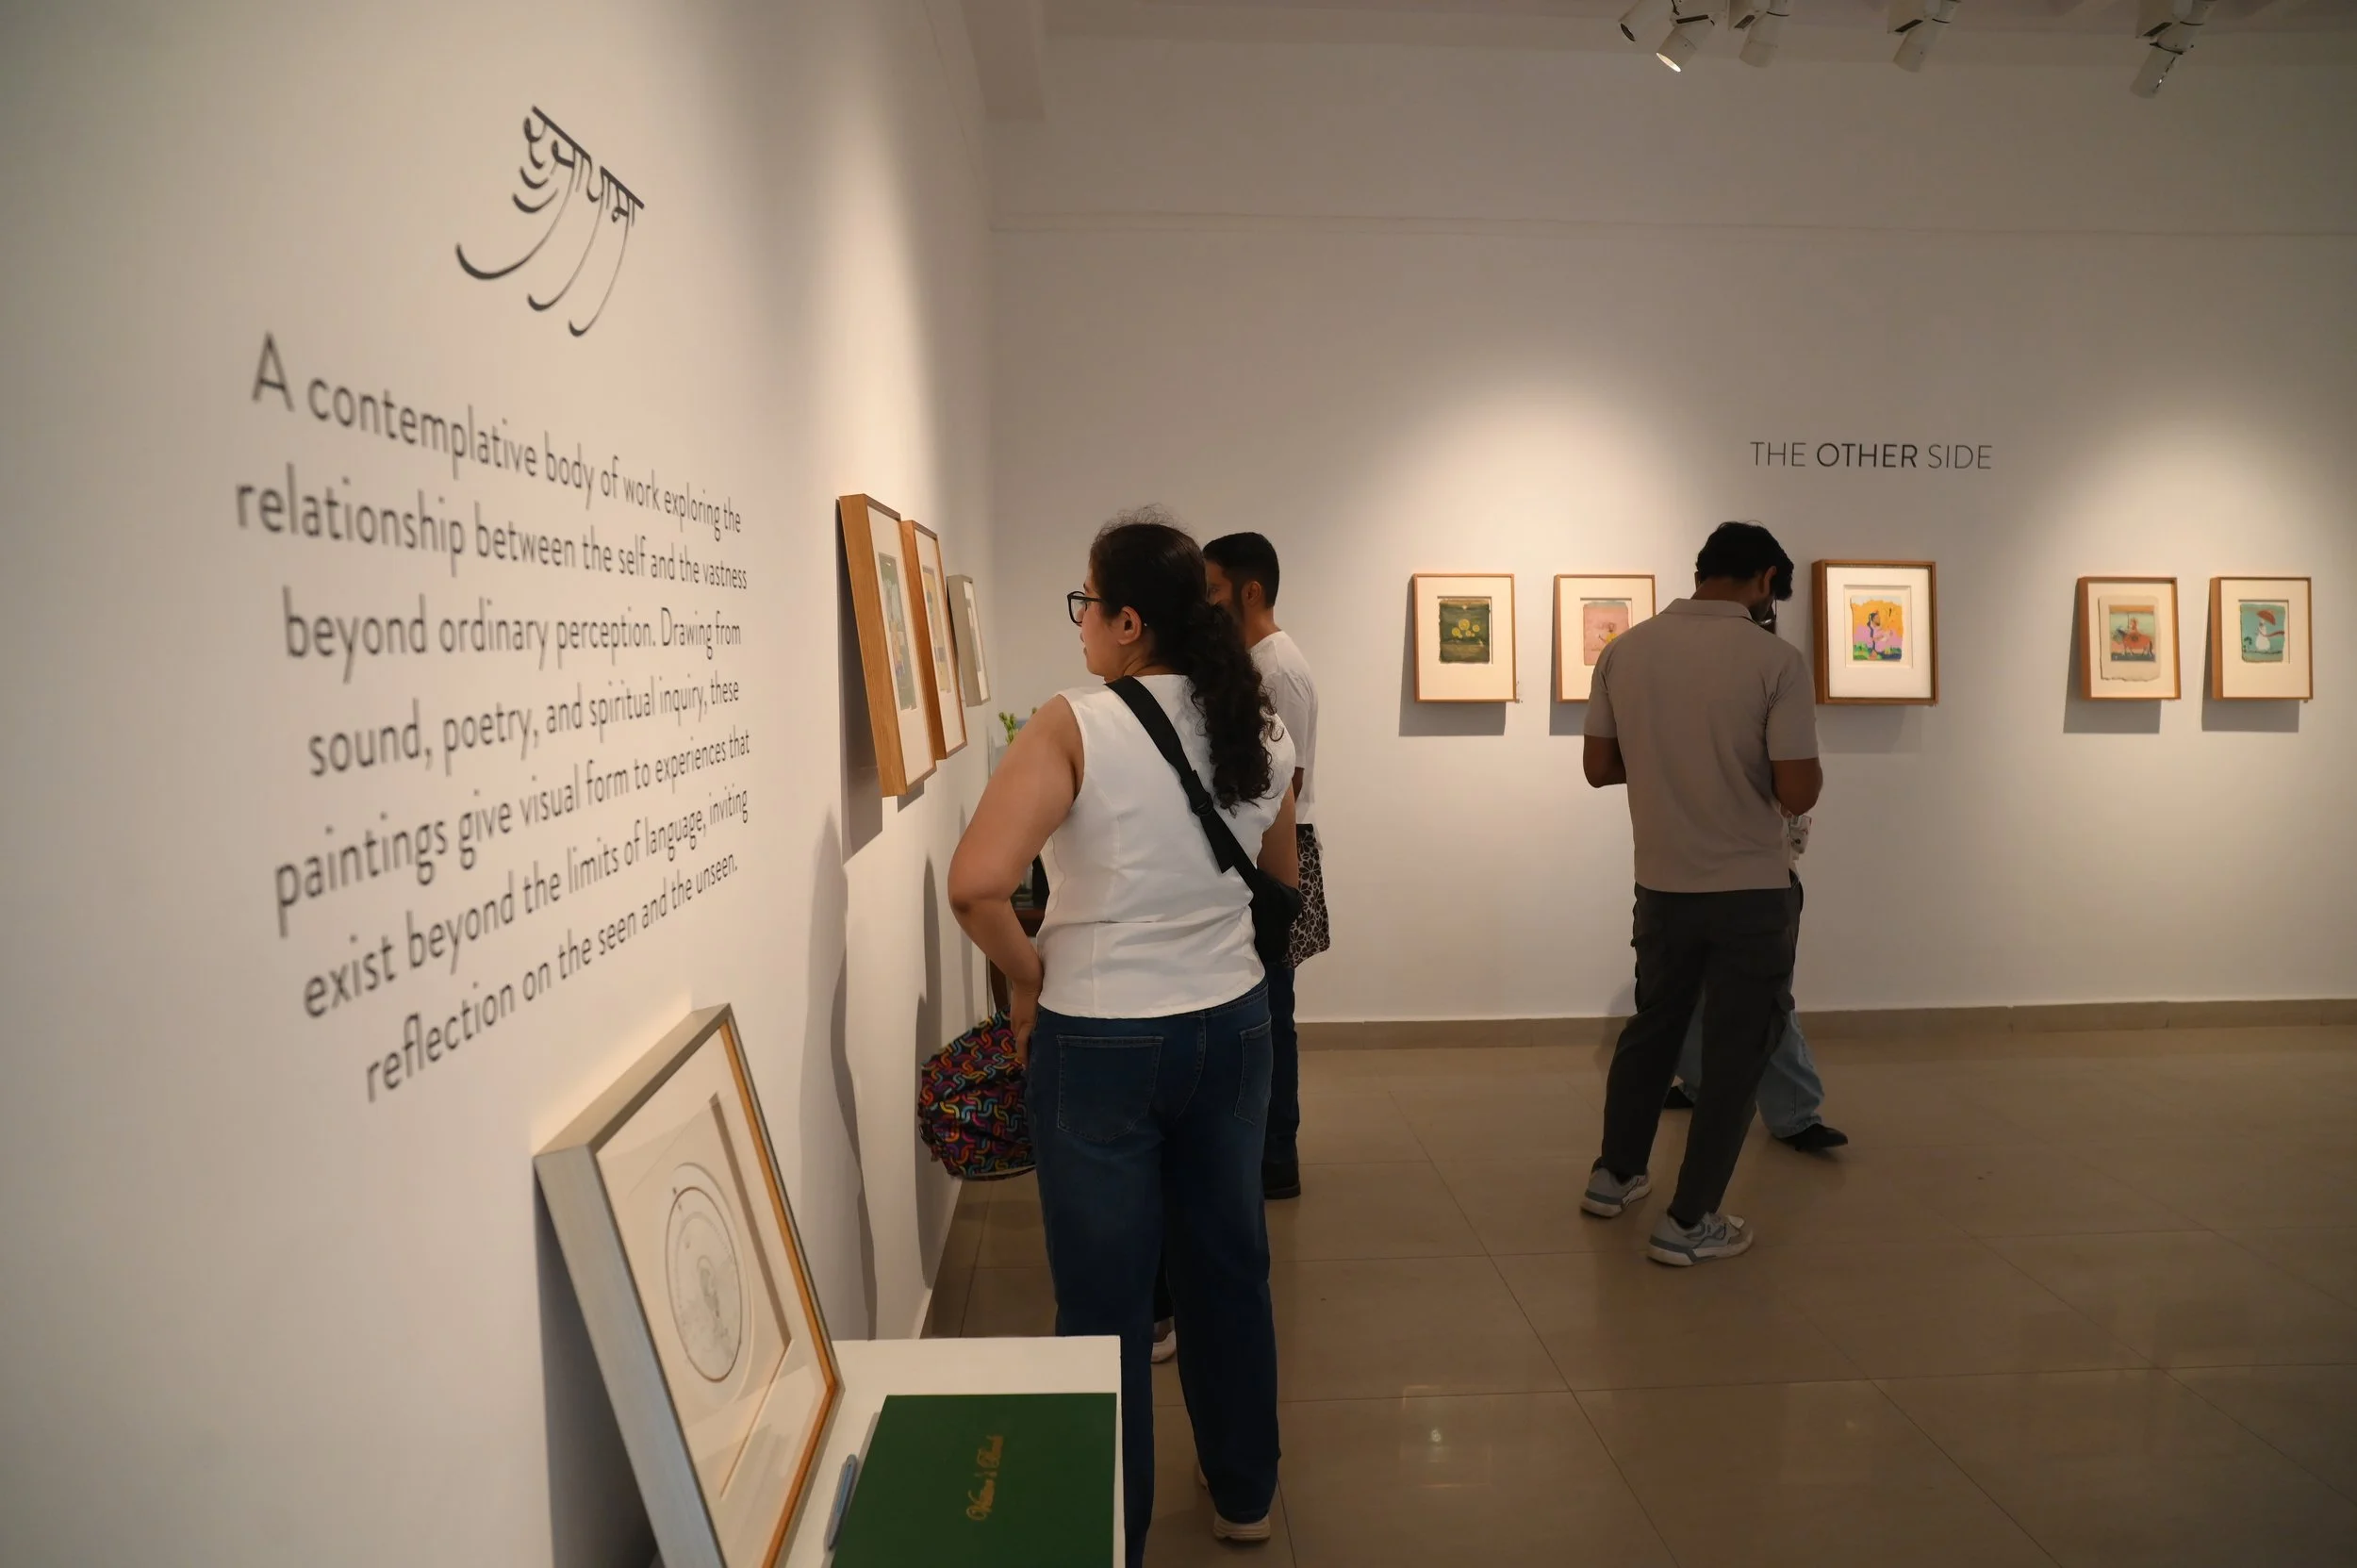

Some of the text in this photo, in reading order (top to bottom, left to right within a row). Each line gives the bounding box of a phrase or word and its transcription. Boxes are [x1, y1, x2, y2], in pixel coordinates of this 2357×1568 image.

[252, 332, 741, 542] A contemplative body of work exploring the
[1750, 441, 1993, 470] THE OTHER SIDE
[236, 463, 747, 589] relationship between the self and the vastness
[283, 586, 741, 684] beyond ordinary perception. Drawing from
[308, 670, 739, 777] sound, poetry, and spiritual inquiry, these
[275, 725, 750, 938] paintings give visual form to experiences that
[304, 784, 748, 1018] exist beyond the limits of language, inviting
[367, 854, 737, 1102] reflection on the seen and the unseen.
